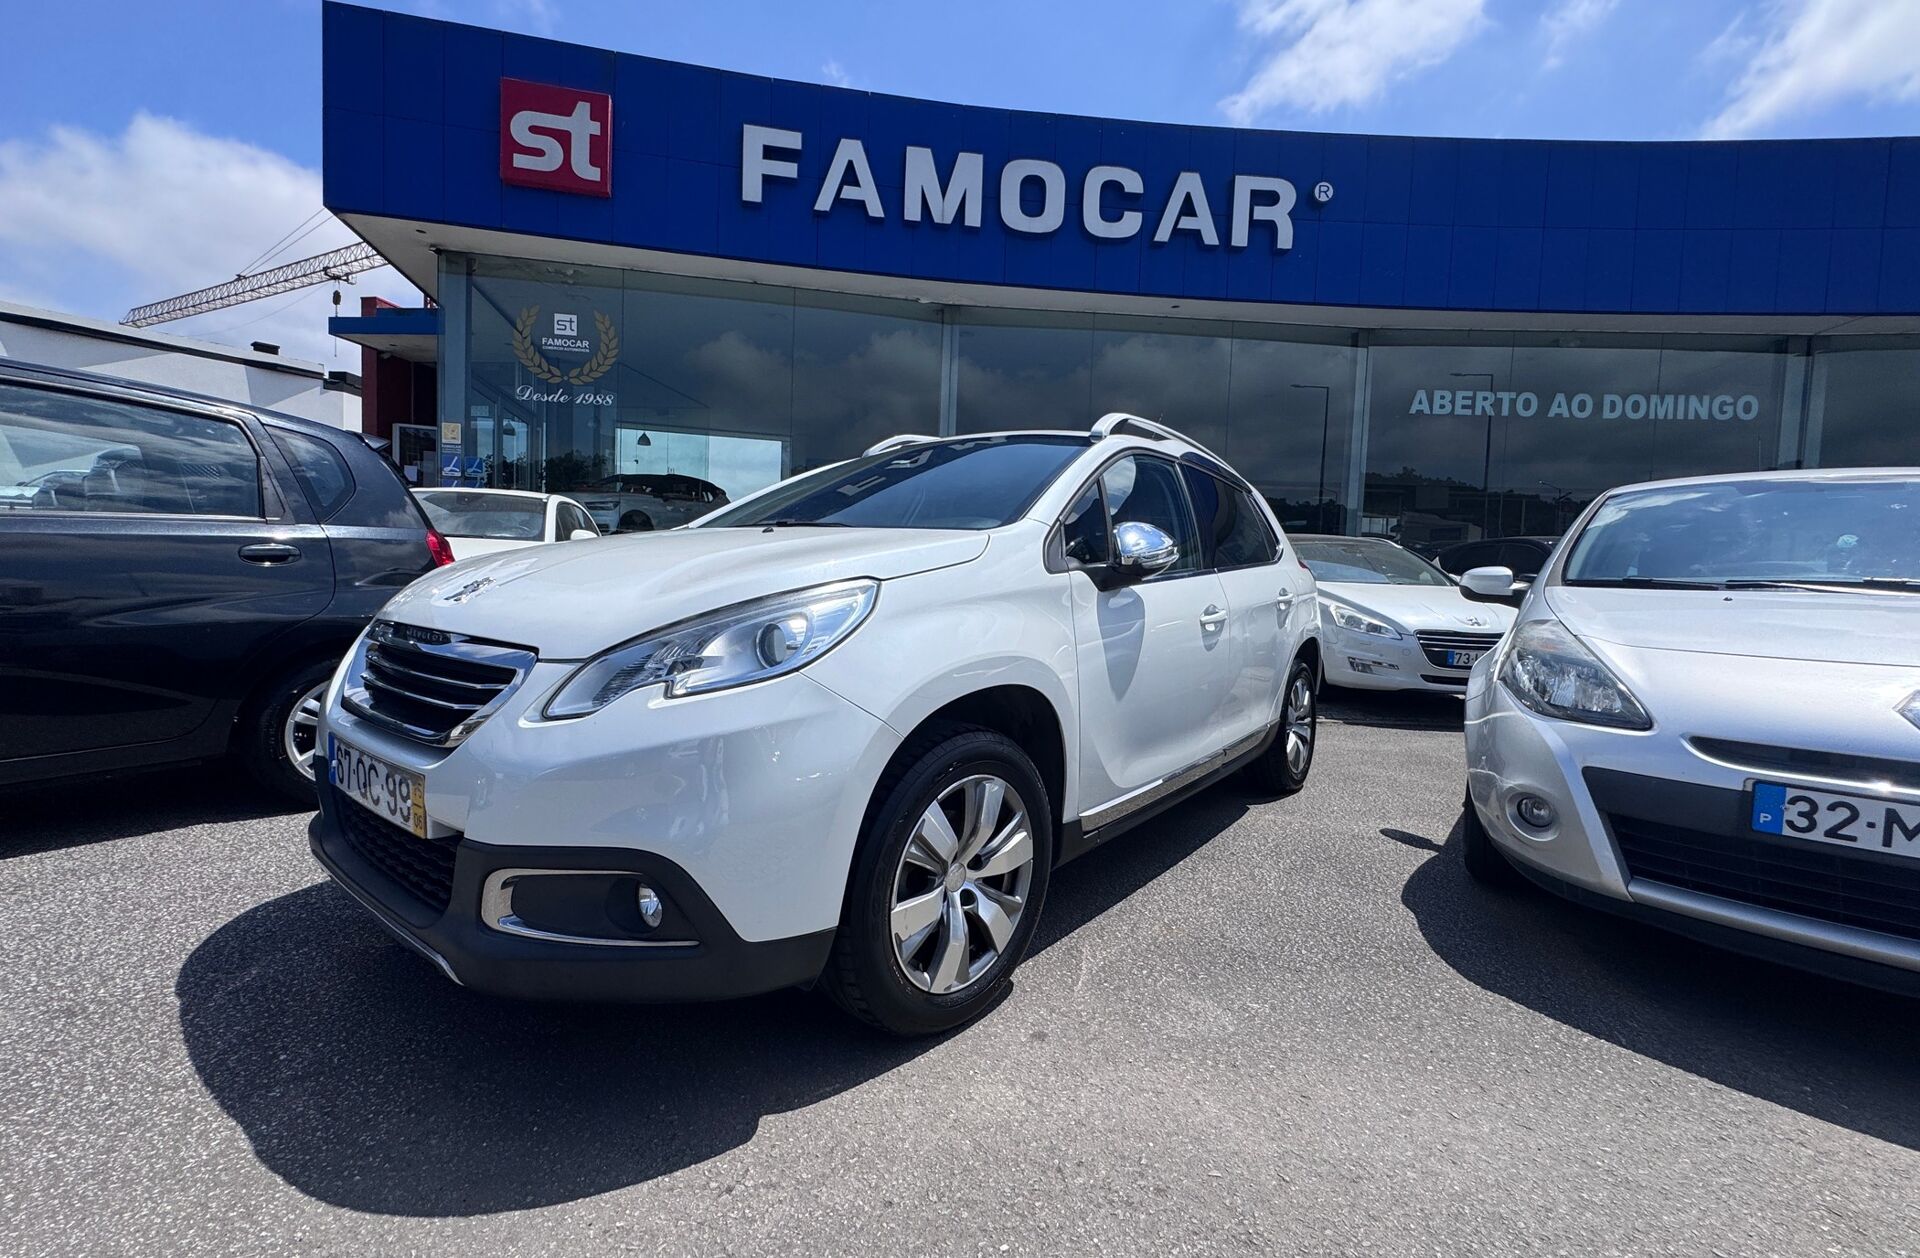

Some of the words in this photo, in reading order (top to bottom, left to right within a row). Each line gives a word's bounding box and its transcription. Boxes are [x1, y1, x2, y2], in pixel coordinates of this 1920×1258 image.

[509, 101, 601, 182] st
[741, 123, 1298, 250] FAMOCAR
[556, 318, 576, 331] st
[541, 337, 590, 349] FAMOCAR
[516, 384, 572, 404] Desde
[574, 392, 615, 406] 1988
[1408, 389, 1539, 417] ABERTO
[1547, 393, 1594, 419] AO
[1602, 393, 1760, 421] DOMINGO
[1759, 812, 1772, 824] P
